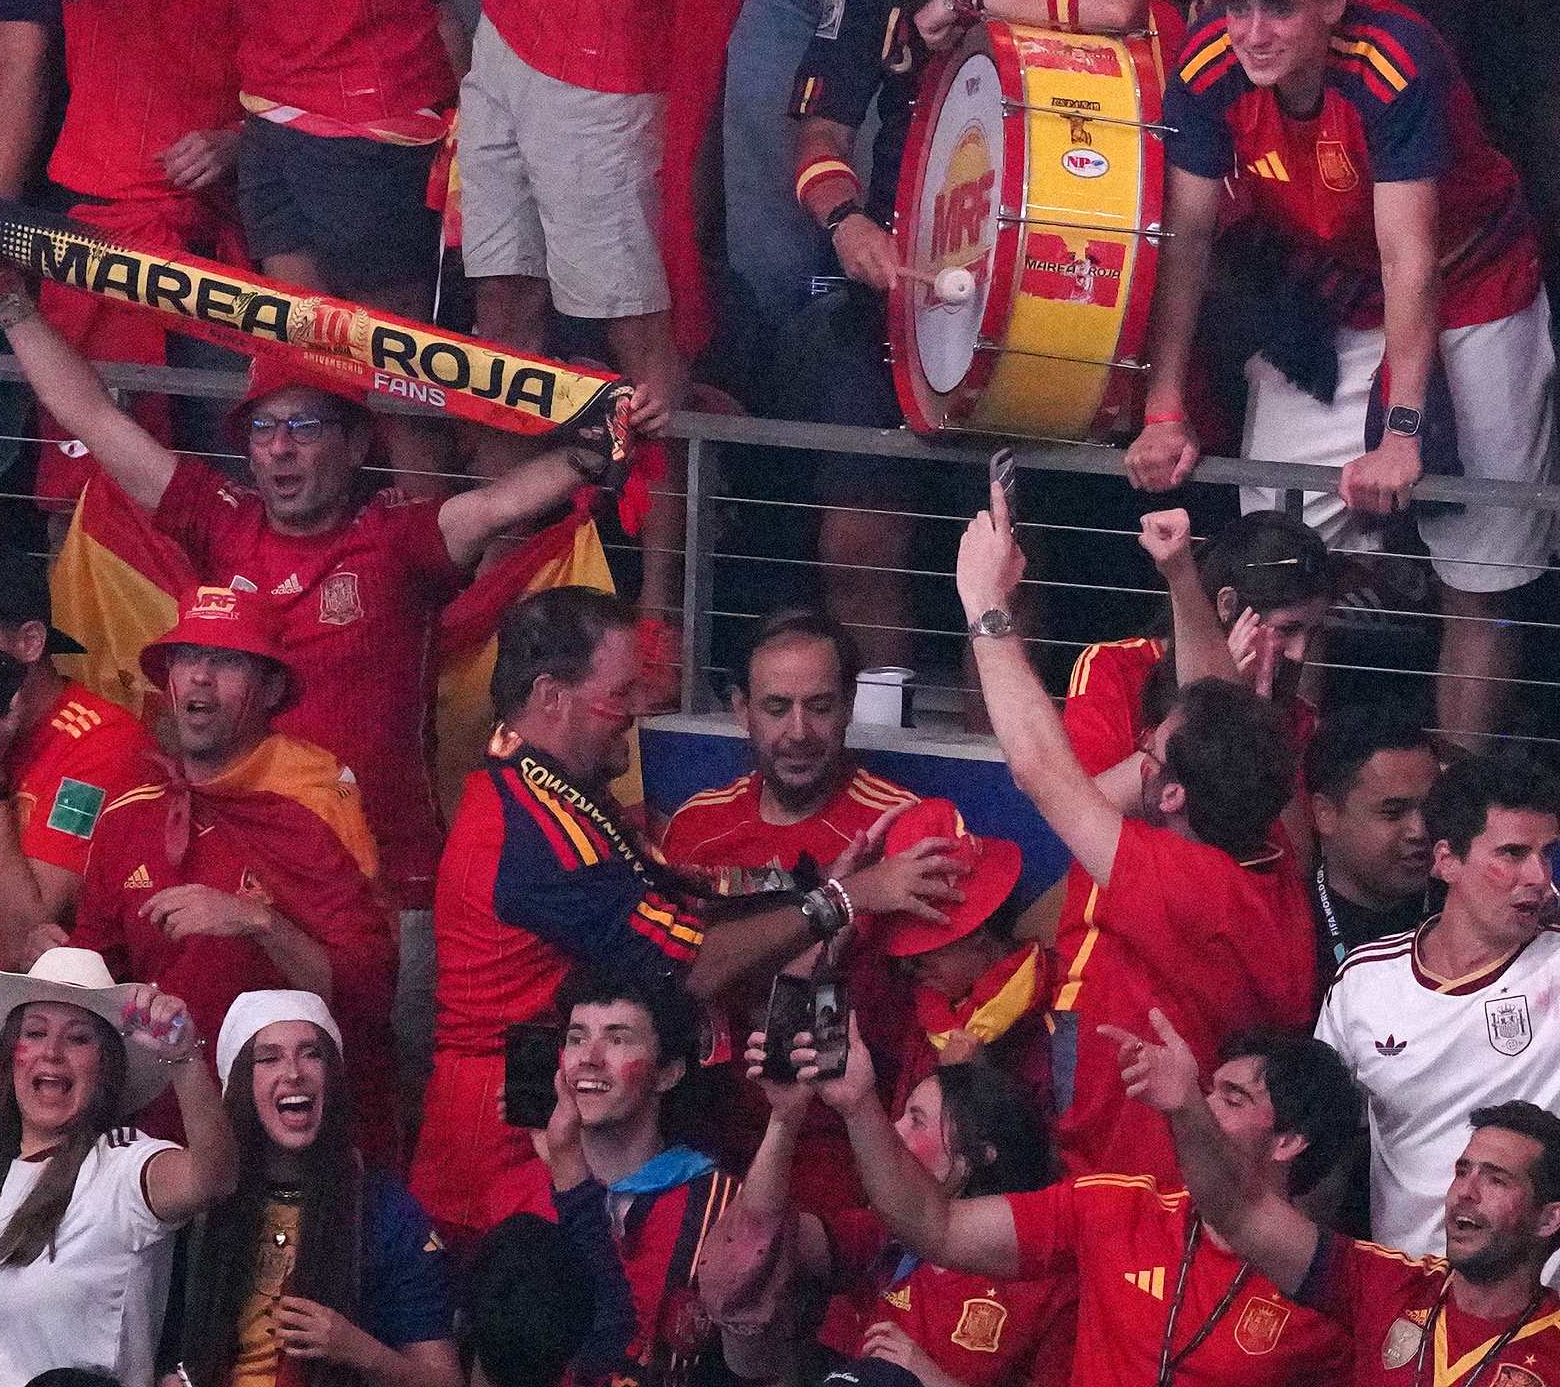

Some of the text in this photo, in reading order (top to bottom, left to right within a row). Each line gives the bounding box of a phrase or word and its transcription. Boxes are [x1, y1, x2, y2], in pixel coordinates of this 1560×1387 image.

[1025, 254, 1122, 280] MAREA ROJA
[30, 230, 557, 419] MAREA ROJA
[372, 372, 447, 408] FANS
